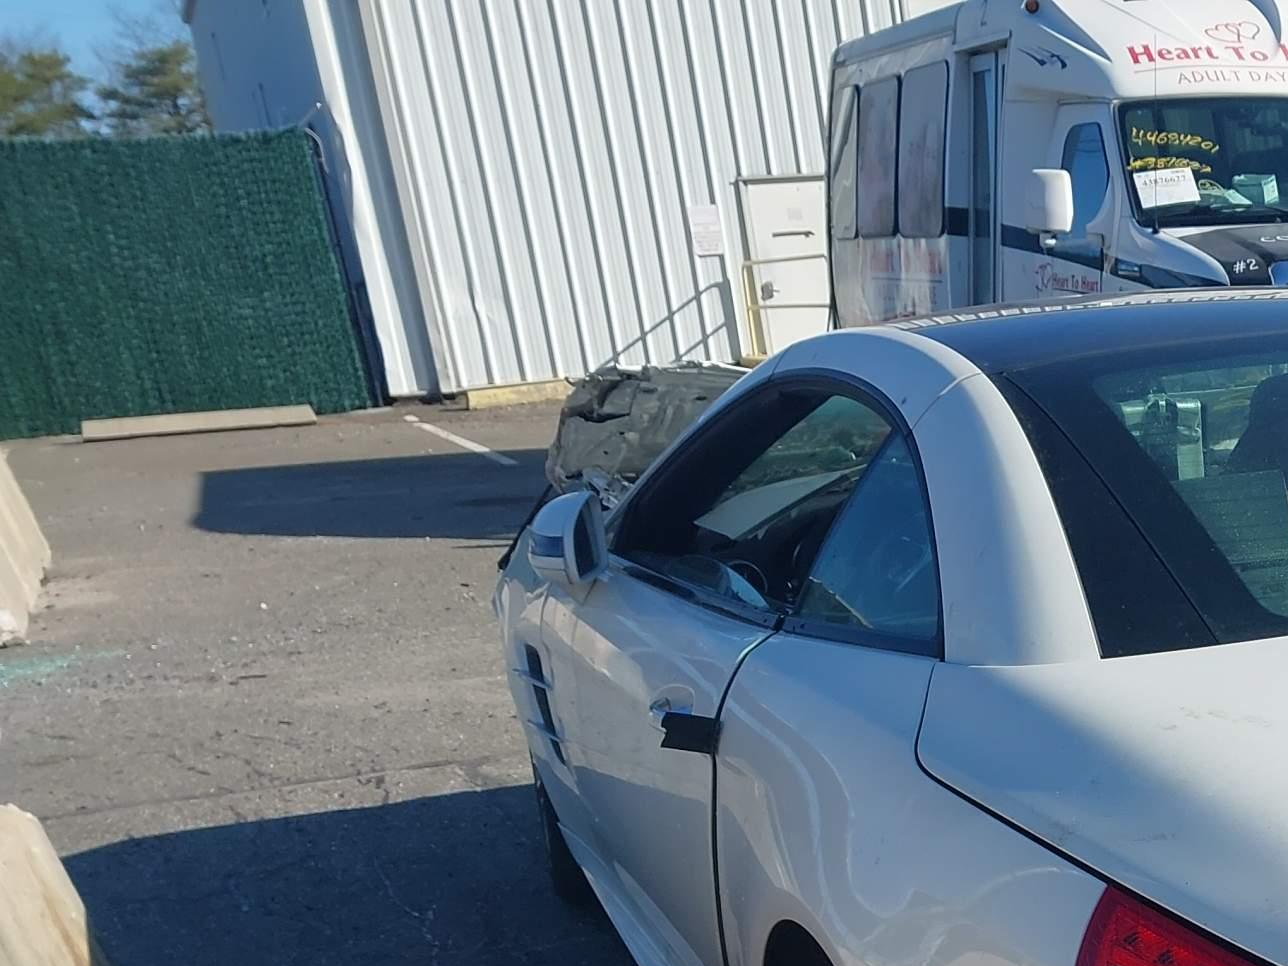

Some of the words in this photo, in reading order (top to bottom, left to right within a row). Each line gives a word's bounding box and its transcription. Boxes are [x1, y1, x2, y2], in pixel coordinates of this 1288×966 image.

[1127, 43, 1220, 64] Heart
[1224, 45, 1269, 61] To
[1178, 70, 1241, 84] ADULT
[1249, 70, 1286, 83] DAY
[1233, 258, 1259, 274] #2
